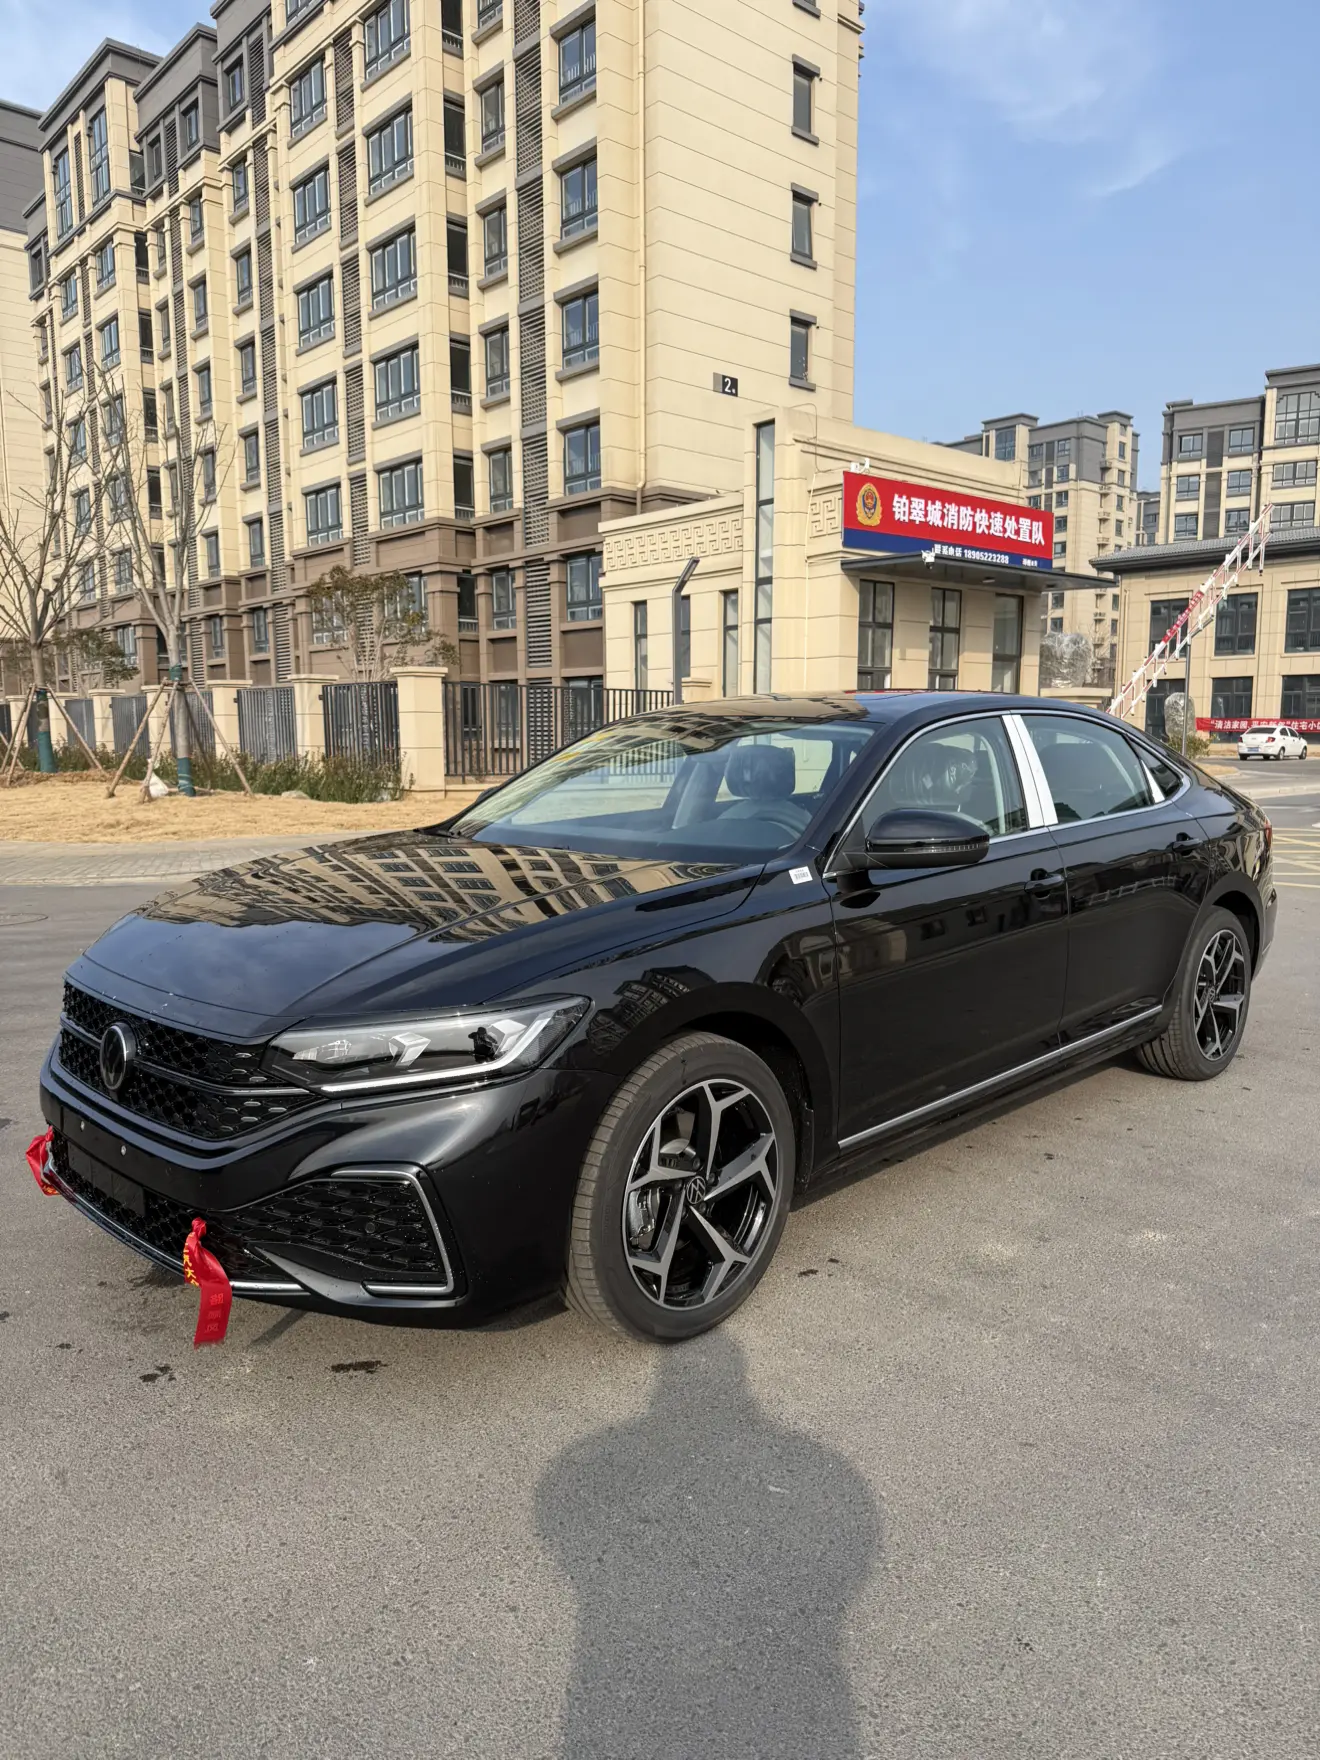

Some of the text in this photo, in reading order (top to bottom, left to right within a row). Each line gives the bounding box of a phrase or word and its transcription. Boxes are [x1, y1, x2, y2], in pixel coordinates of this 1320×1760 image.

[892, 493, 1046, 546] 铂翠城消防快速处置队
